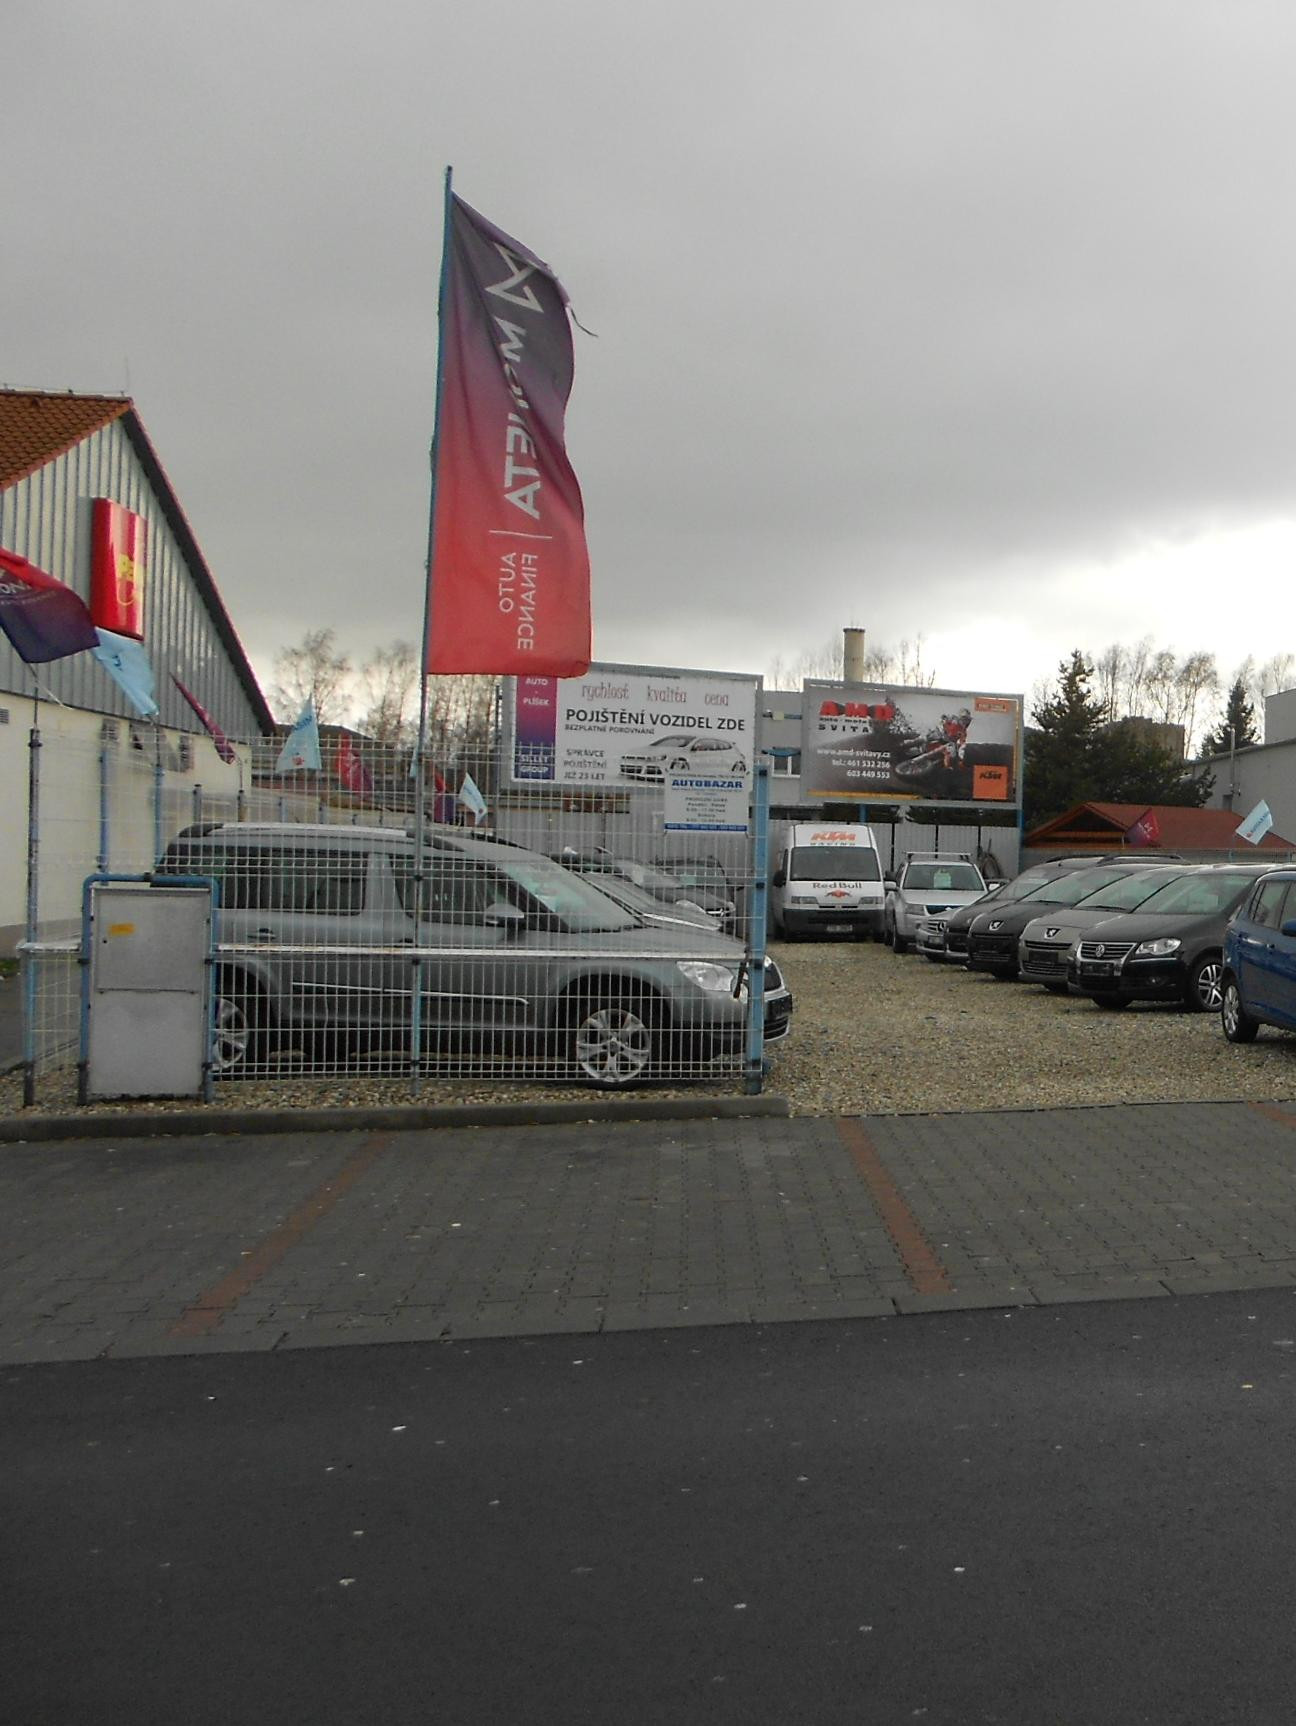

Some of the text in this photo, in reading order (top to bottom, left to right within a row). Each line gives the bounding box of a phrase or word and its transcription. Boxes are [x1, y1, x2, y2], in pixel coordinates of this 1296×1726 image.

[565, 708, 746, 731] POJIŠTĚNÍ VOZIDEL ZDE
[671, 779, 743, 788] AUTOBAZAR
